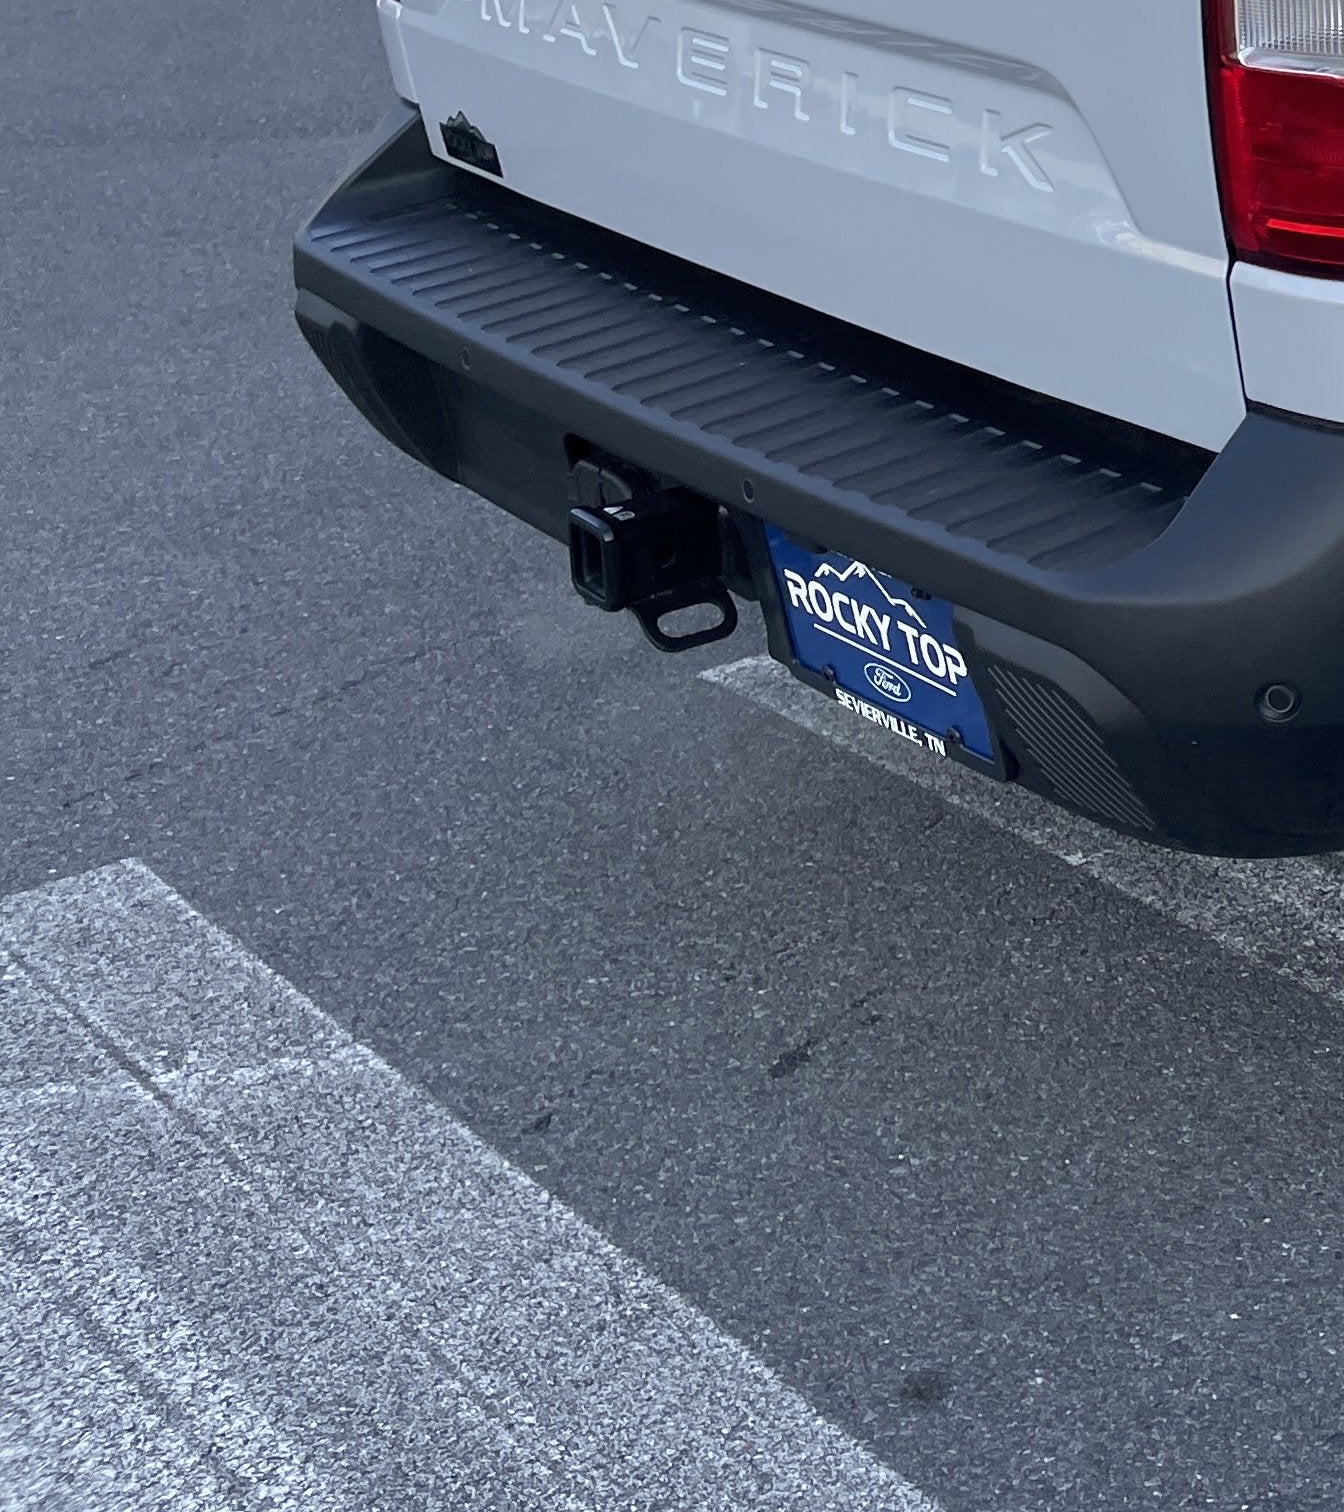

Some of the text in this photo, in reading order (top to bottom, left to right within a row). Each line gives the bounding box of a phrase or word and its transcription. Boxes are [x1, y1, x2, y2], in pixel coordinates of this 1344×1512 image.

[784, 568, 968, 685] ROCKY TOP
[873, 667, 902, 697] Ford
[924, 732, 947, 757] TN
